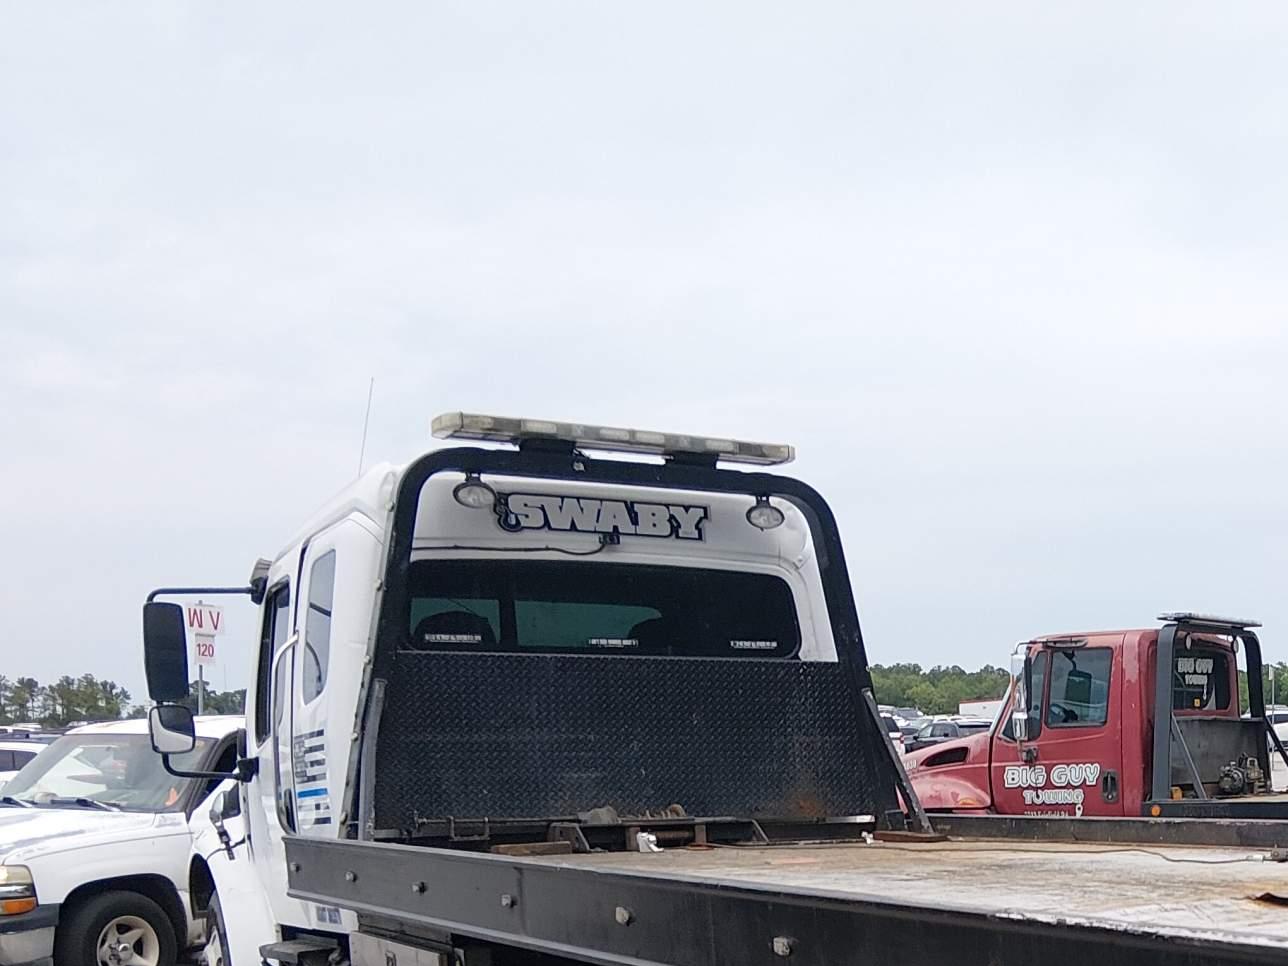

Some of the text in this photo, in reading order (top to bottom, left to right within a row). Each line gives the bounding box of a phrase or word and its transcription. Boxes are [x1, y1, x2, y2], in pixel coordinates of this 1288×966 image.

[507, 493, 710, 541] SWABY
[196, 642, 215, 658] 120
[1004, 763, 1101, 788] BIG GUY
[1023, 789, 1085, 806] TOWING
